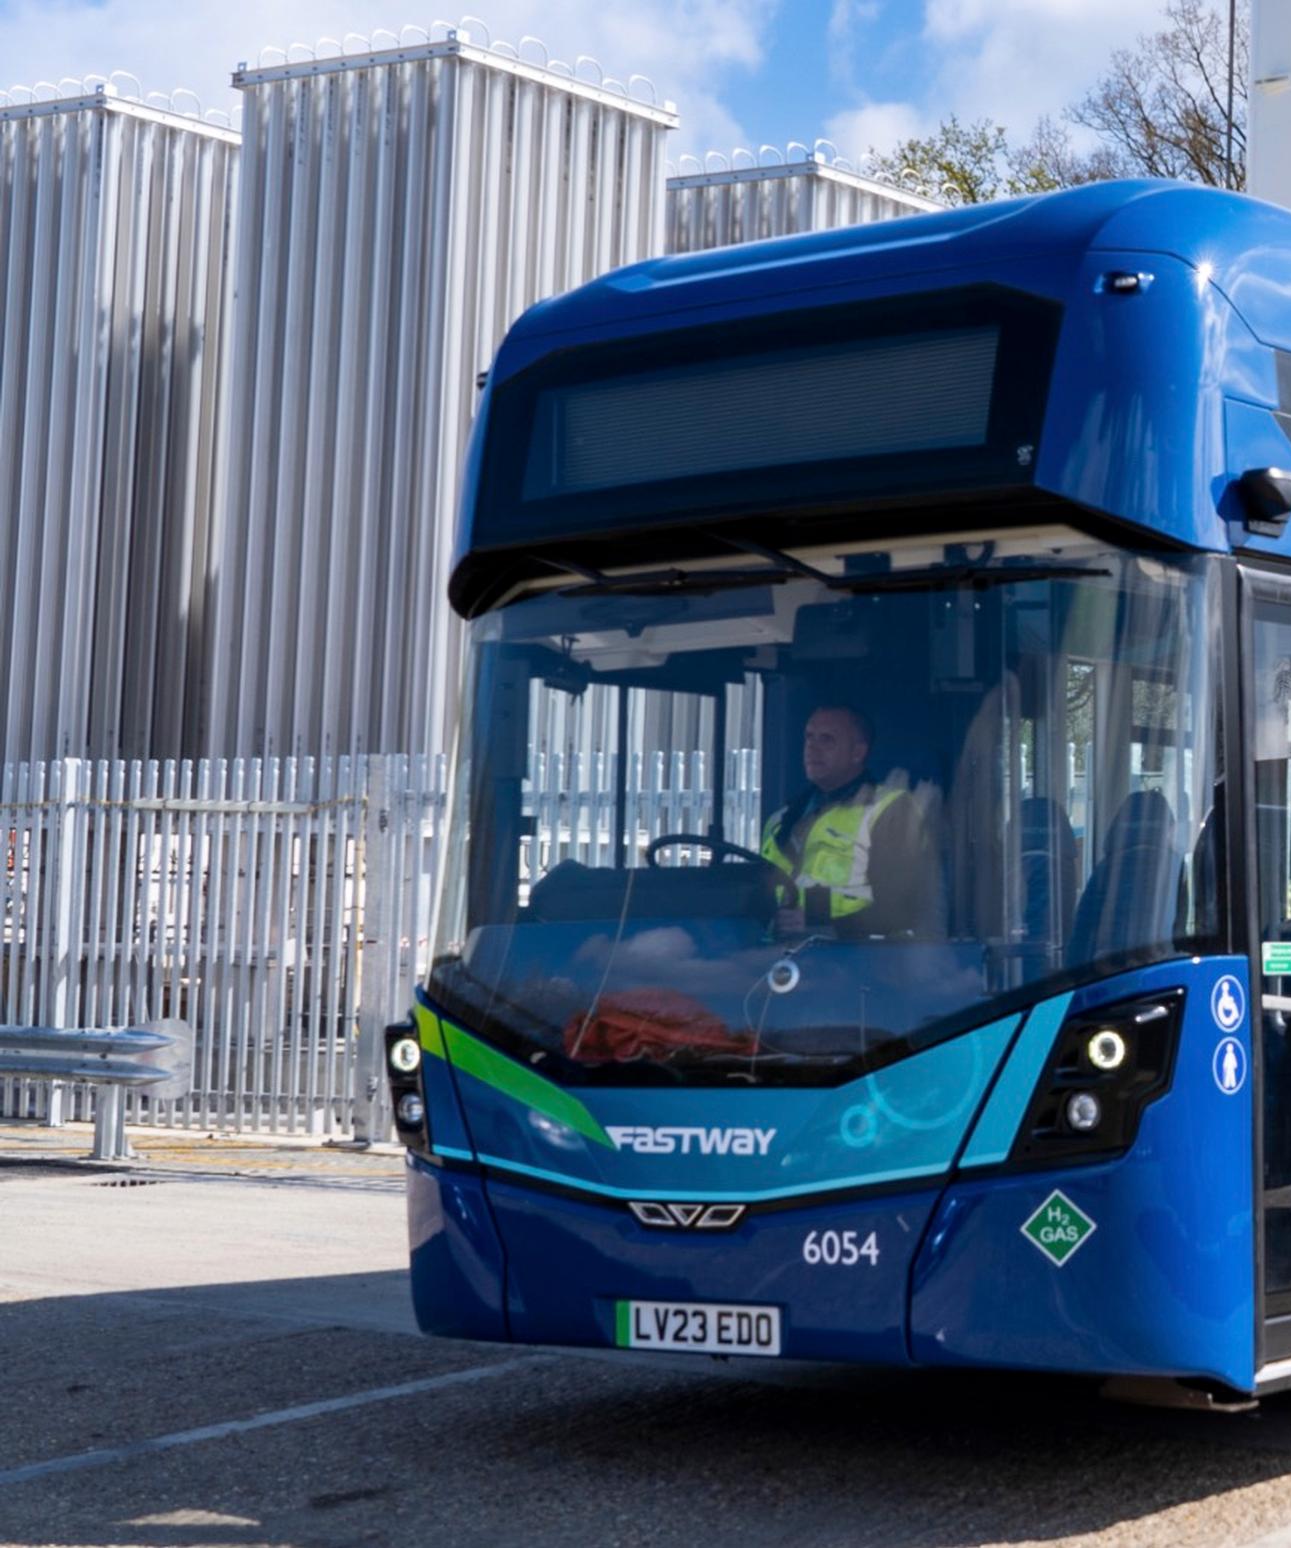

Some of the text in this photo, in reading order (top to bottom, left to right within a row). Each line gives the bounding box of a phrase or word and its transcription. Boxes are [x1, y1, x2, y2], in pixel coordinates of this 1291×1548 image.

[803, 1231, 880, 1265] 6054
[1040, 1226, 1078, 1242] GAS
[635, 1307, 772, 1346] LV23 EDO
